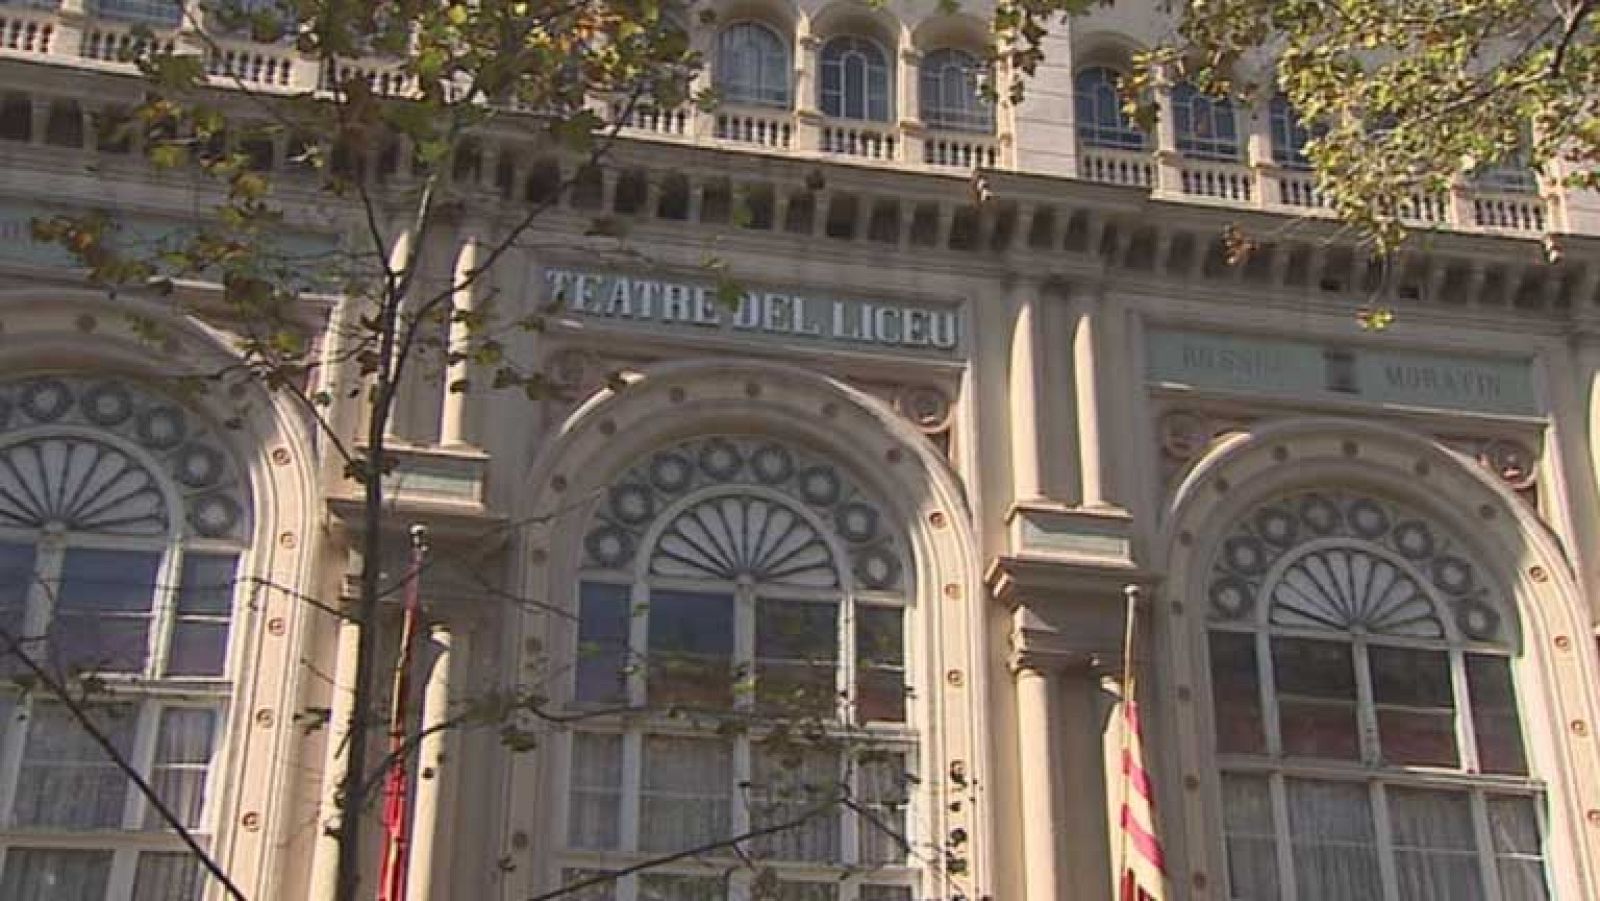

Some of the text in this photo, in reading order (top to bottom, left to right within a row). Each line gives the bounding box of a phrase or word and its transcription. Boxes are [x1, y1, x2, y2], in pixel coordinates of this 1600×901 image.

[544, 269, 957, 349] TEATRE DEL LICEU
